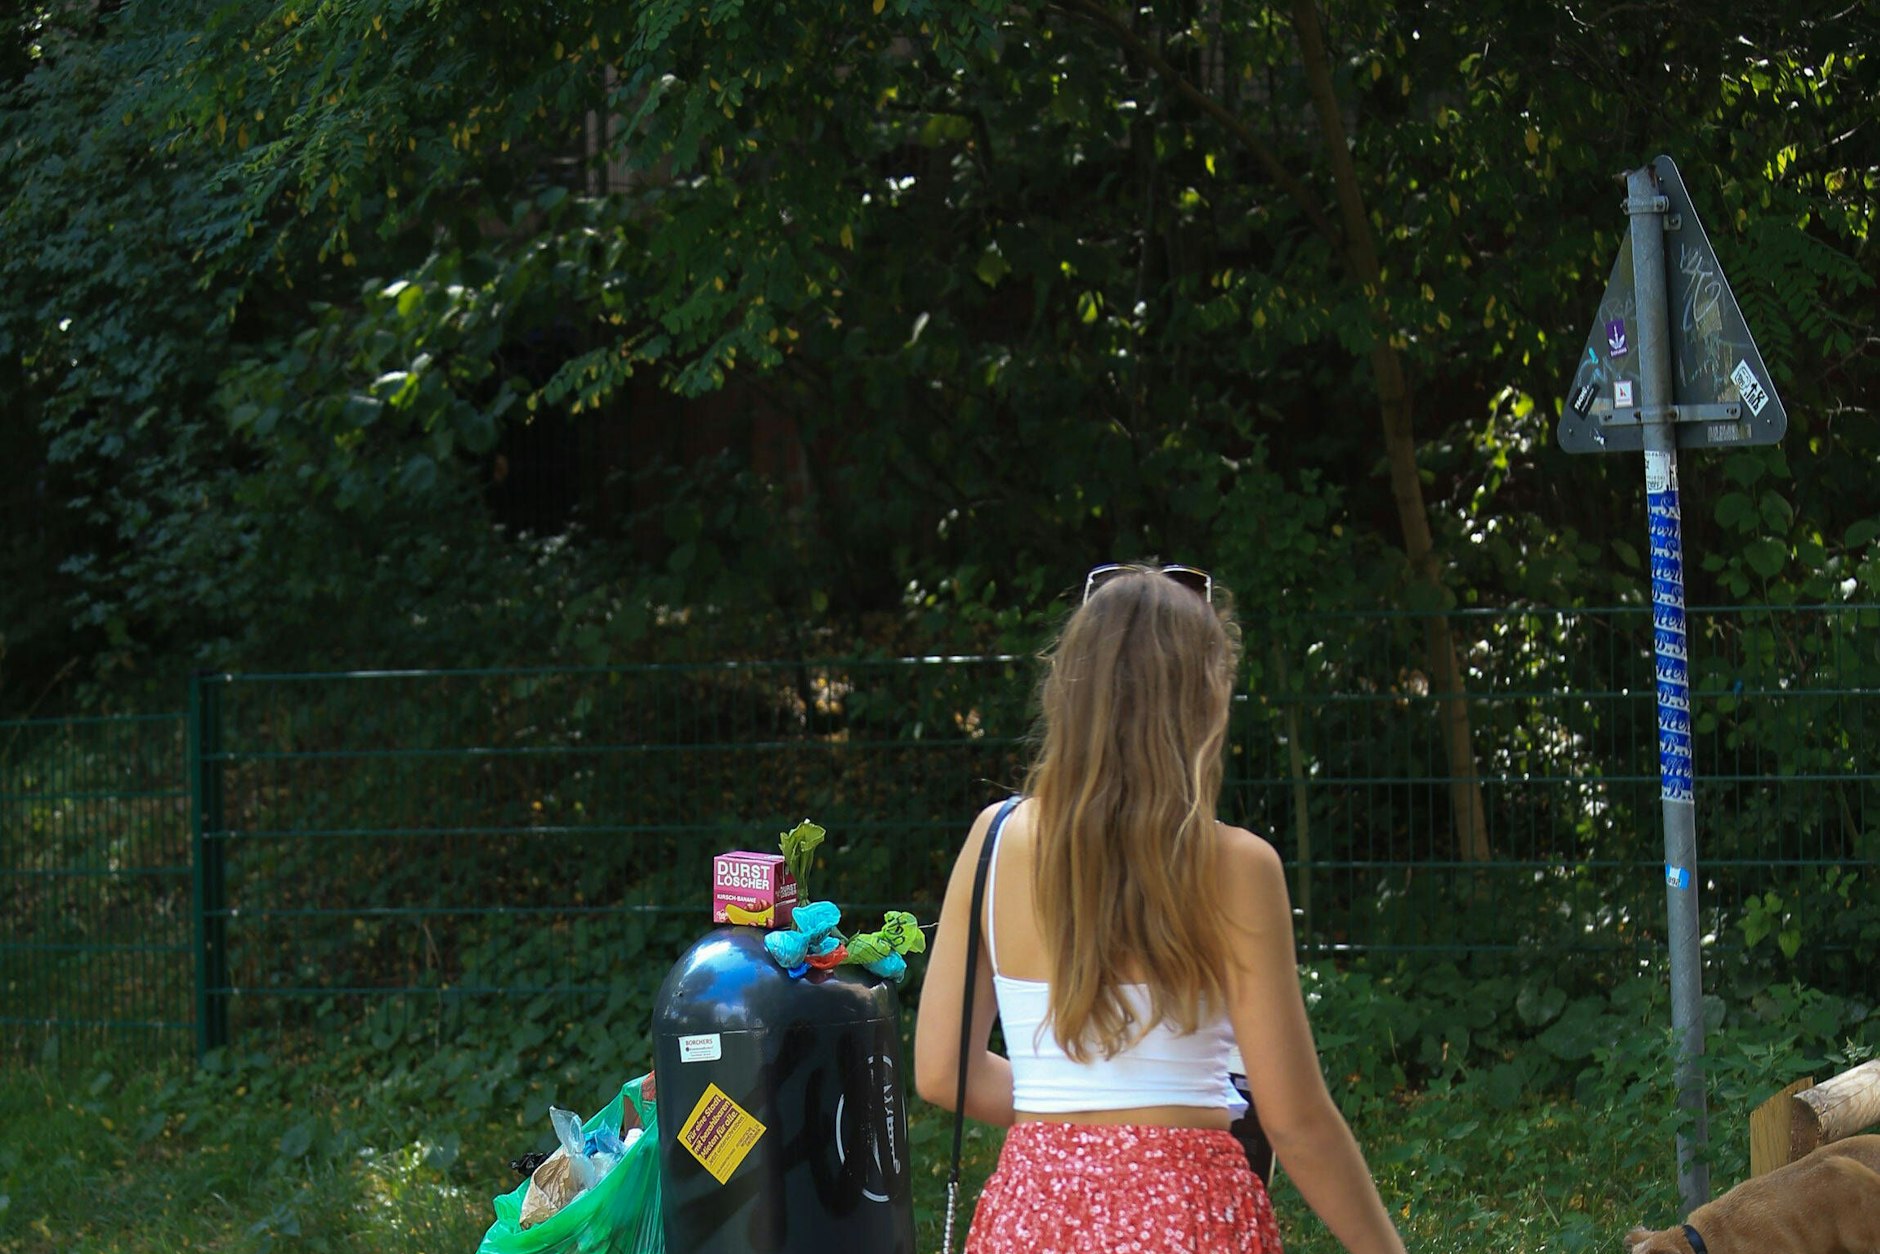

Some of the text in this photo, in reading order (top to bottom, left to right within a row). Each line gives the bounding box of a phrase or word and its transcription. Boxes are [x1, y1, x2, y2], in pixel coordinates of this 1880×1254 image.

[717, 861, 770, 880] DURST
[717, 874, 770, 890] LÖSCHER
[687, 1095, 721, 1143] Für eine Stadt
[694, 1139, 704, 1154] mit
[700, 1100, 730, 1142] bezahlbaren
[700, 1135, 719, 1158] Mieten
[716, 1122, 727, 1138] für
